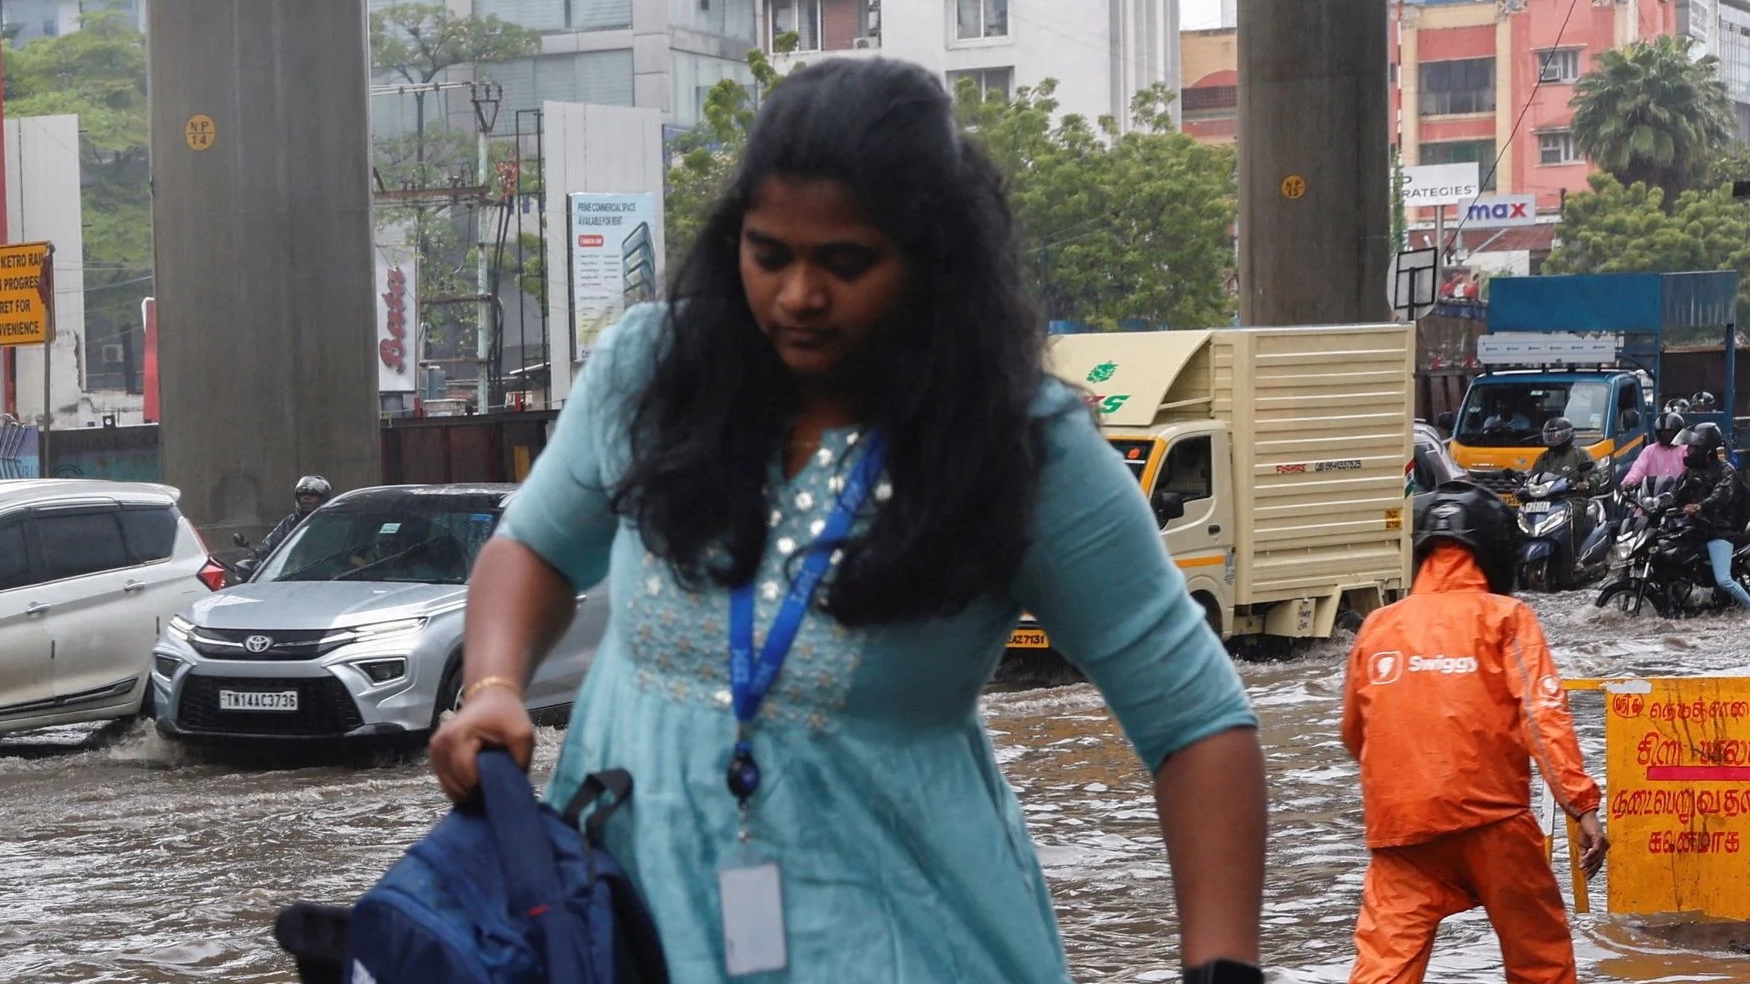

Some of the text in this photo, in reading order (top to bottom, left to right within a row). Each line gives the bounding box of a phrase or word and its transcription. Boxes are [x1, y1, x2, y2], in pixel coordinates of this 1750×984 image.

[1402, 186, 1472, 198] RATEGIES
[1468, 203, 1528, 220] max
[4, 275, 41, 291] PROGRES
[16, 299, 31, 312] FOR
[379, 267, 405, 374] Bata
[1408, 654, 1479, 674] Swiggy
